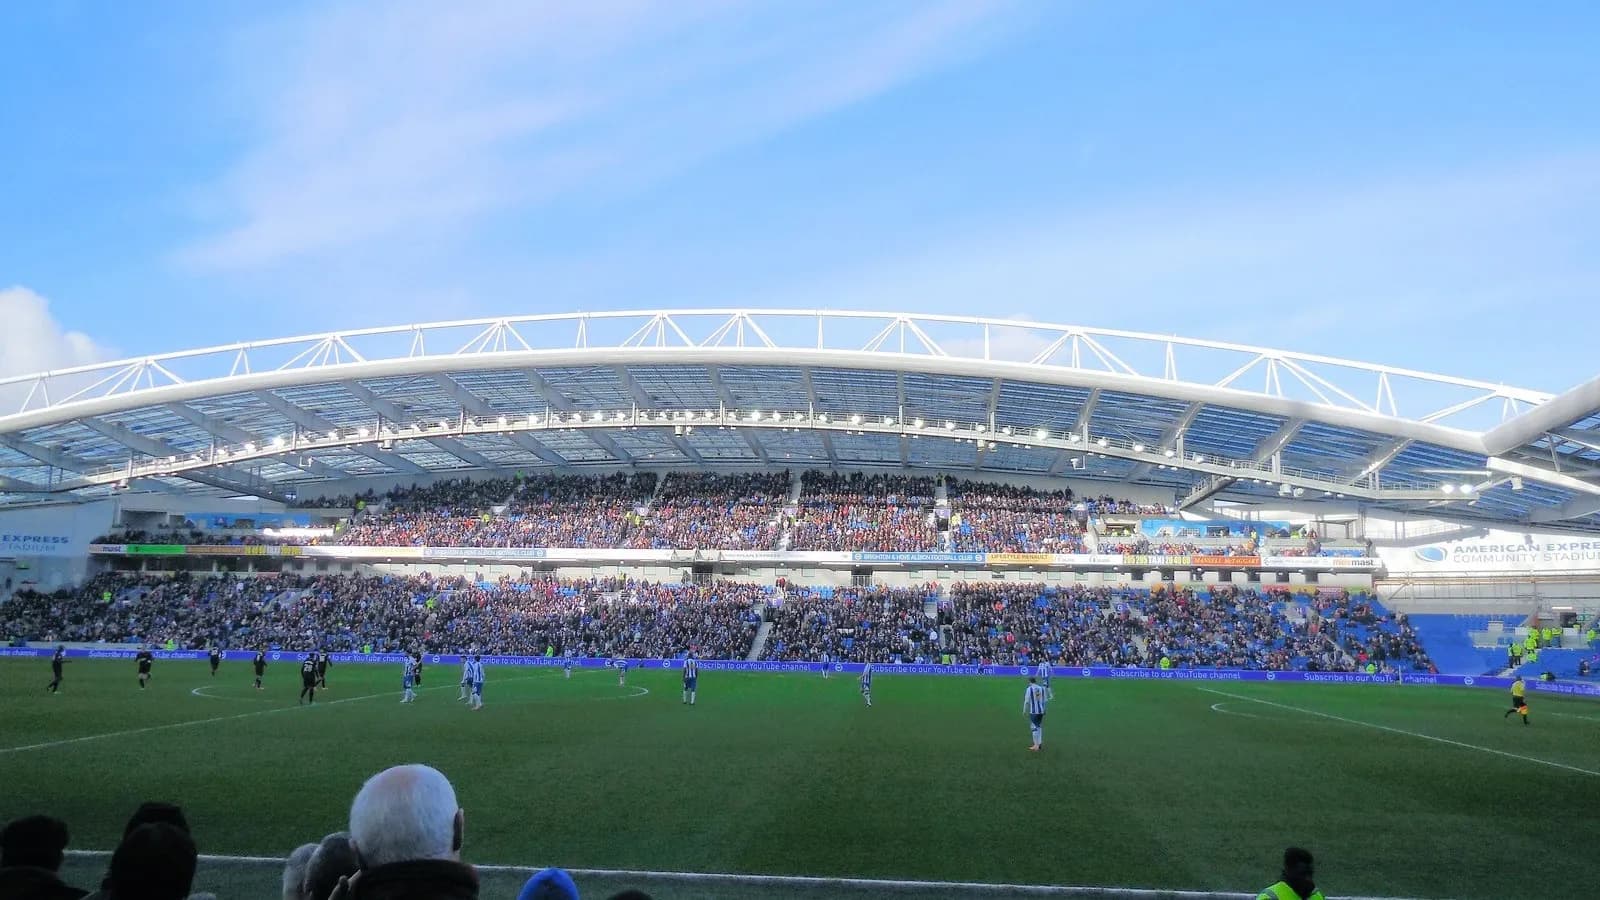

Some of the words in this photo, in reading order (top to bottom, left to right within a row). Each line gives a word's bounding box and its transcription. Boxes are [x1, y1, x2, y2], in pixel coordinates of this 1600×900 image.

[3, 535, 69, 543] EXPRESS
[1454, 544, 1540, 554] AMERICAN
[1546, 541, 1600, 551] EXPRE
[1453, 553, 1536, 563] COMMUNITY
[353, 653, 381, 662] YouTube
[524, 657, 552, 665] YouTube
[749, 662, 780, 671] YouTube
[781, 663, 811, 671] channel
[871, 664, 907, 673] Subscribe
[933, 665, 963, 674] YouTube
[1110, 669, 1150, 678] Subscribe
[1151, 670, 1159, 678] to
[1175, 670, 1207, 679] YouTube
[1209, 671, 1241, 680] channel
[1303, 672, 1343, 681] Subscribe
[1345, 673, 1353, 681] to
[1355, 674, 1370, 682] our
[1404, 674, 1437, 683] channel
